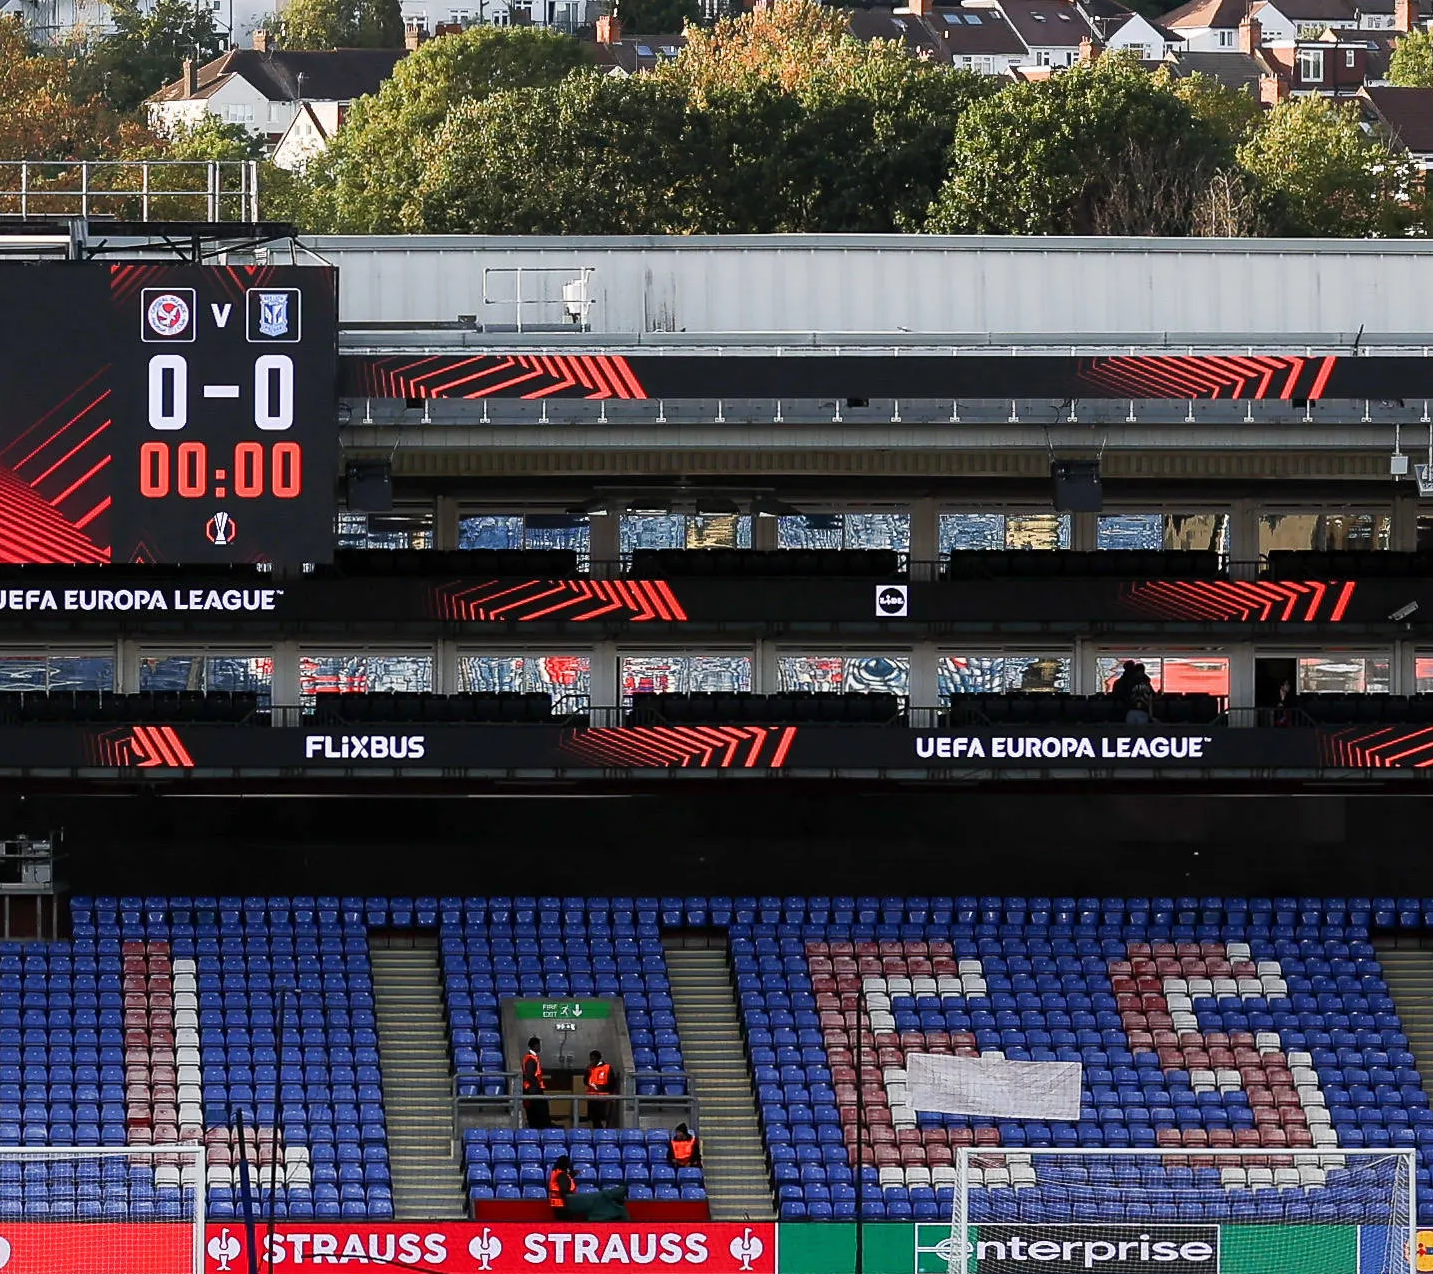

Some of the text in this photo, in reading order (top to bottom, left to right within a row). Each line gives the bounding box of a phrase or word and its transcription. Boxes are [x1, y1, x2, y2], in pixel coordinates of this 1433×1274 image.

[140, 441, 302, 498] 00:00
[64, 589, 168, 611] EUROPA
[916, 736, 986, 758] UEFA
[991, 736, 1096, 758] EUROPA
[263, 1233, 447, 1265] STRAUSS
[523, 1232, 708, 1264] STRAUSS
[935, 1233, 1213, 1268] enterprise
